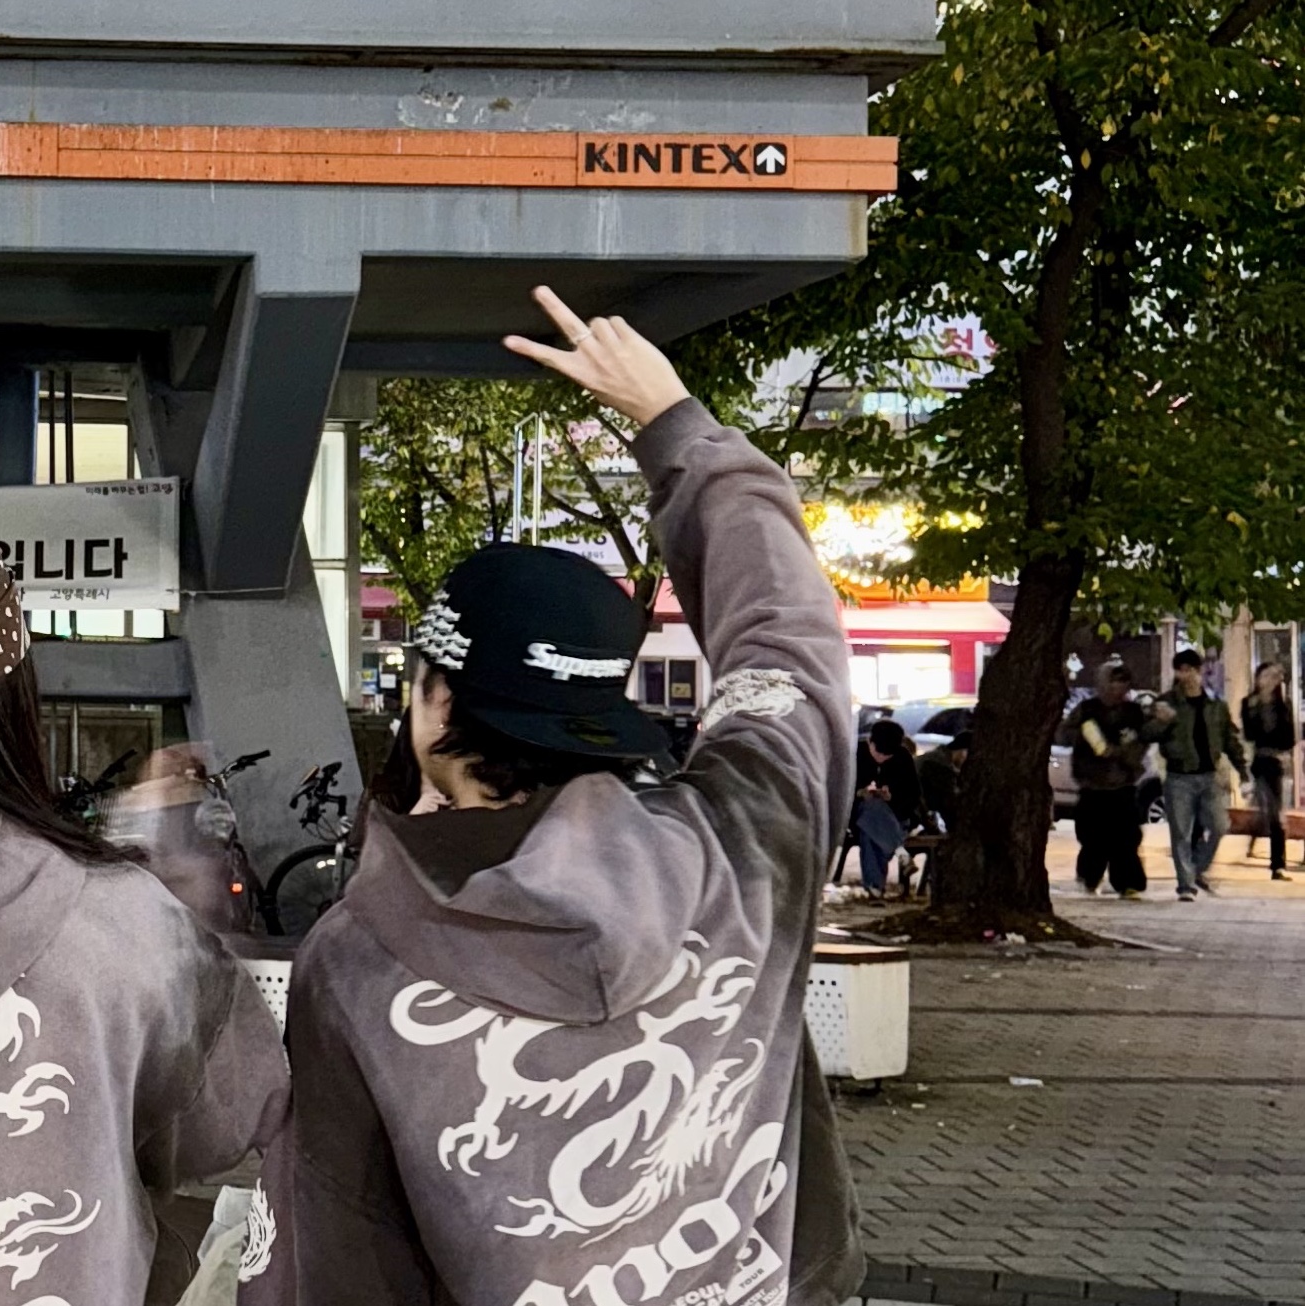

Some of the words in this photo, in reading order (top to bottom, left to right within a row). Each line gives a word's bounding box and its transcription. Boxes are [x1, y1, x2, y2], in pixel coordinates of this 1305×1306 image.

[585, 142, 750, 174] KINTEX
[50, 587, 111, 600] 고양특례시
[738, 1267, 765, 1289] TOUR
